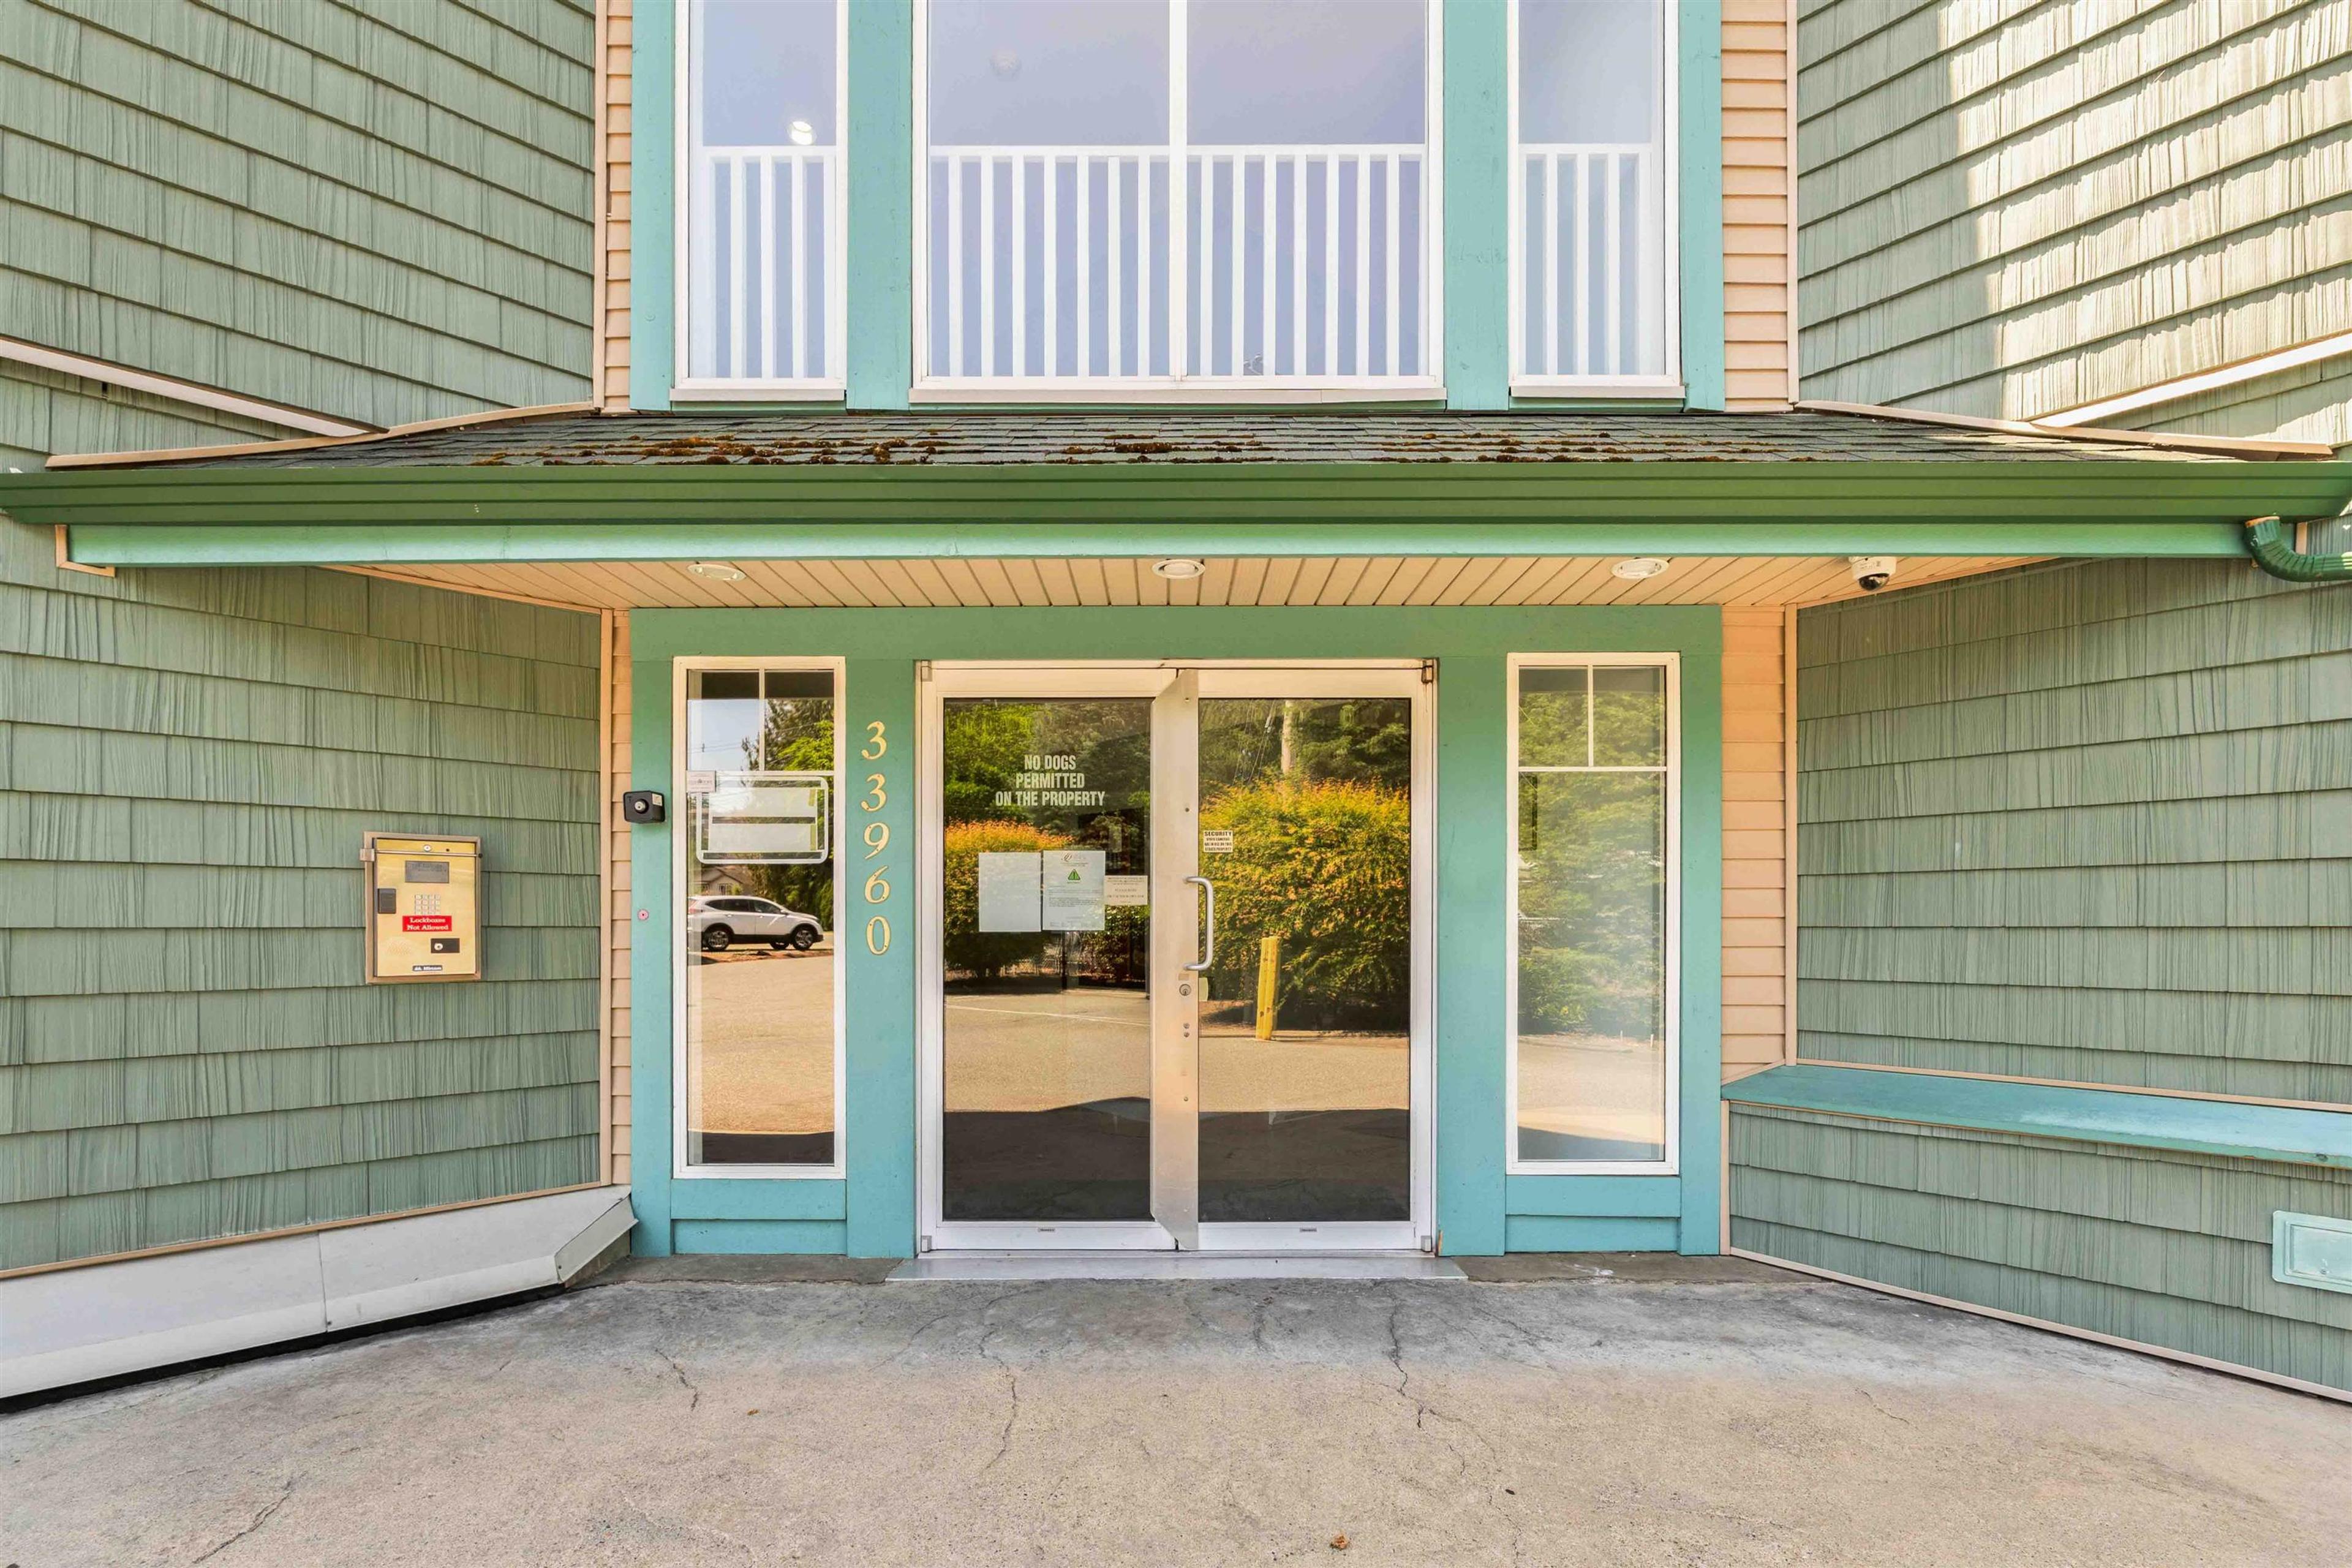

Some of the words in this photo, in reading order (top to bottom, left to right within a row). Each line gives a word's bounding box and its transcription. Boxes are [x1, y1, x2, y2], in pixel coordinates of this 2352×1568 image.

[1024, 755, 1041, 771] NO
[1044, 755, 1076, 771] DOGS
[1016, 773, 1085, 789] PERMITTED
[995, 791, 1012, 806] ON
[1016, 791, 1038, 806] THE
[1042, 791, 1106, 806] PROPERTY
[861, 720, 892, 956] 33960
